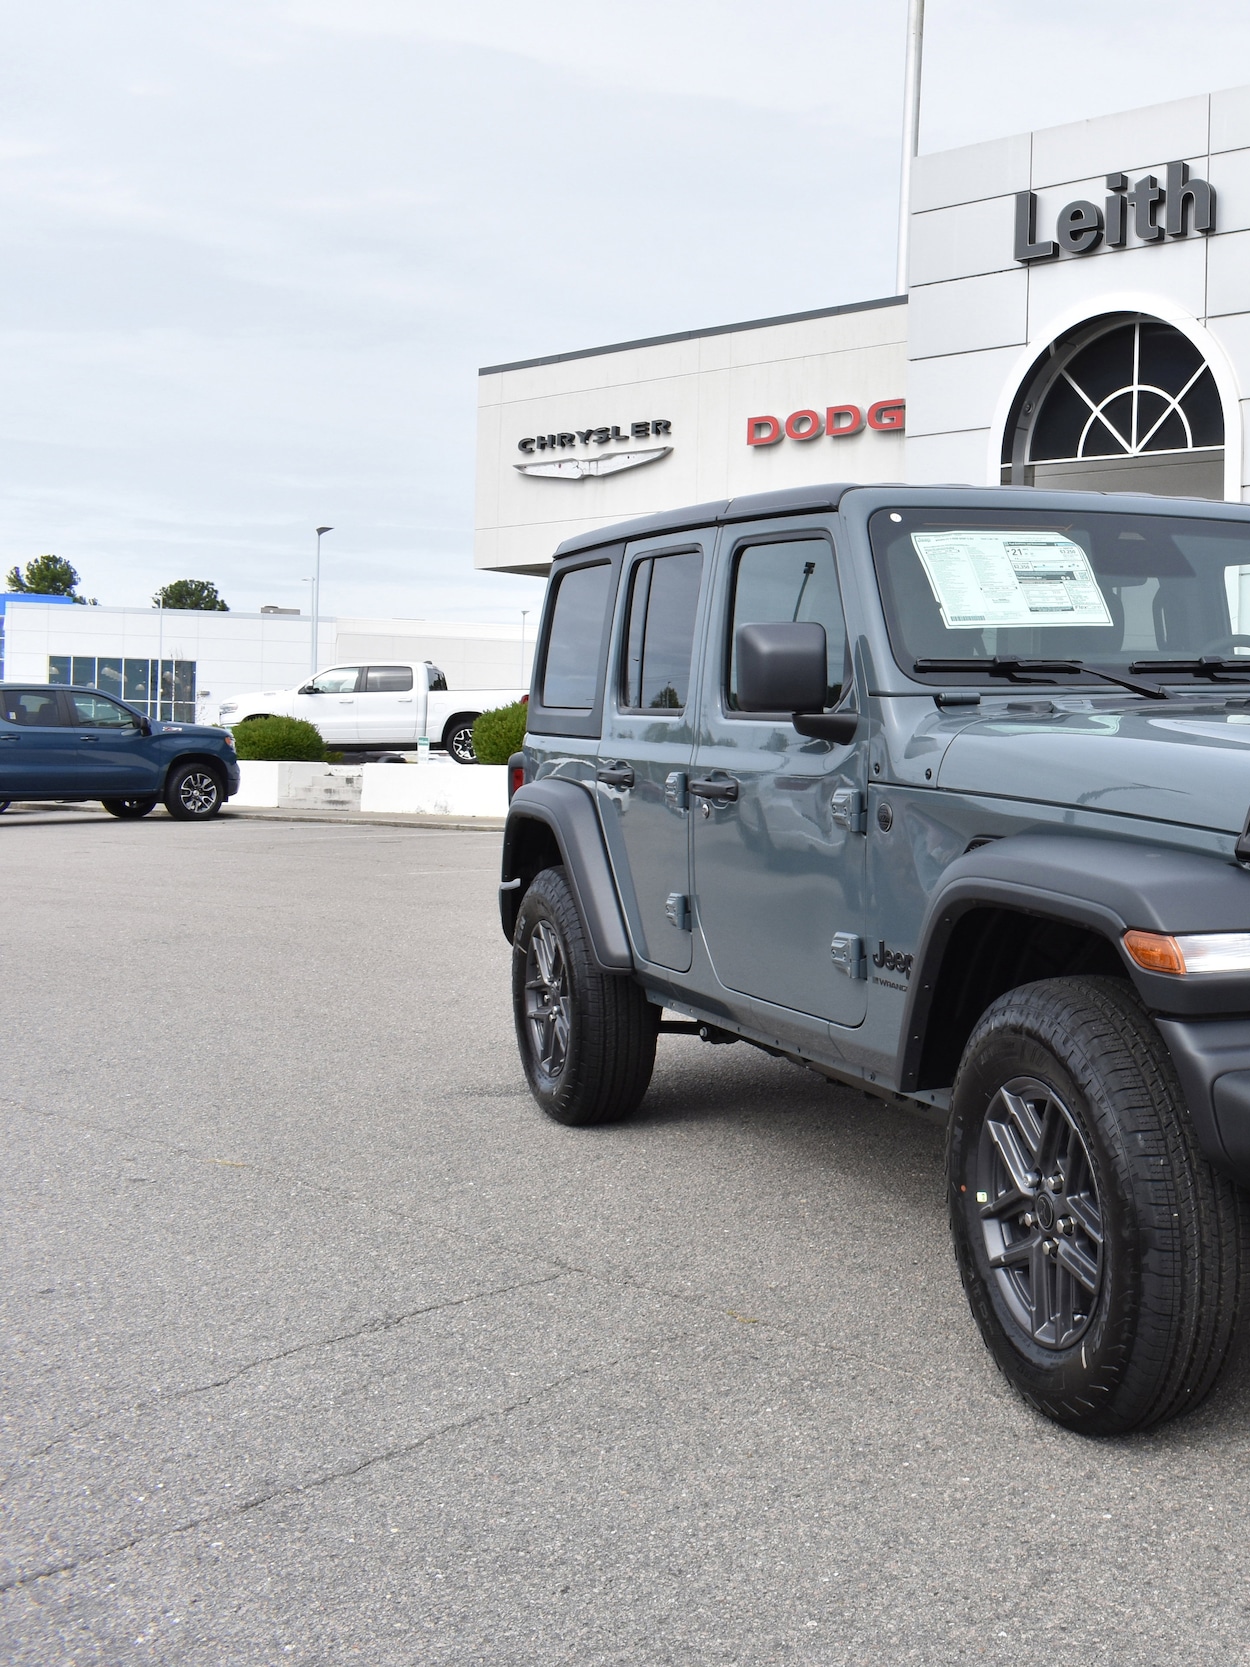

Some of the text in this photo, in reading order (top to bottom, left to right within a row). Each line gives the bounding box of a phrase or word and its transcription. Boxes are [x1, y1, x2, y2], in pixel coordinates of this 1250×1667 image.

[1014, 161, 1217, 264] Leith
[518, 419, 672, 453] CHRYSLER
[747, 398, 905, 446] DODG
[1011, 548, 1022, 556] 21
[879, 977, 908, 992] WRANG
